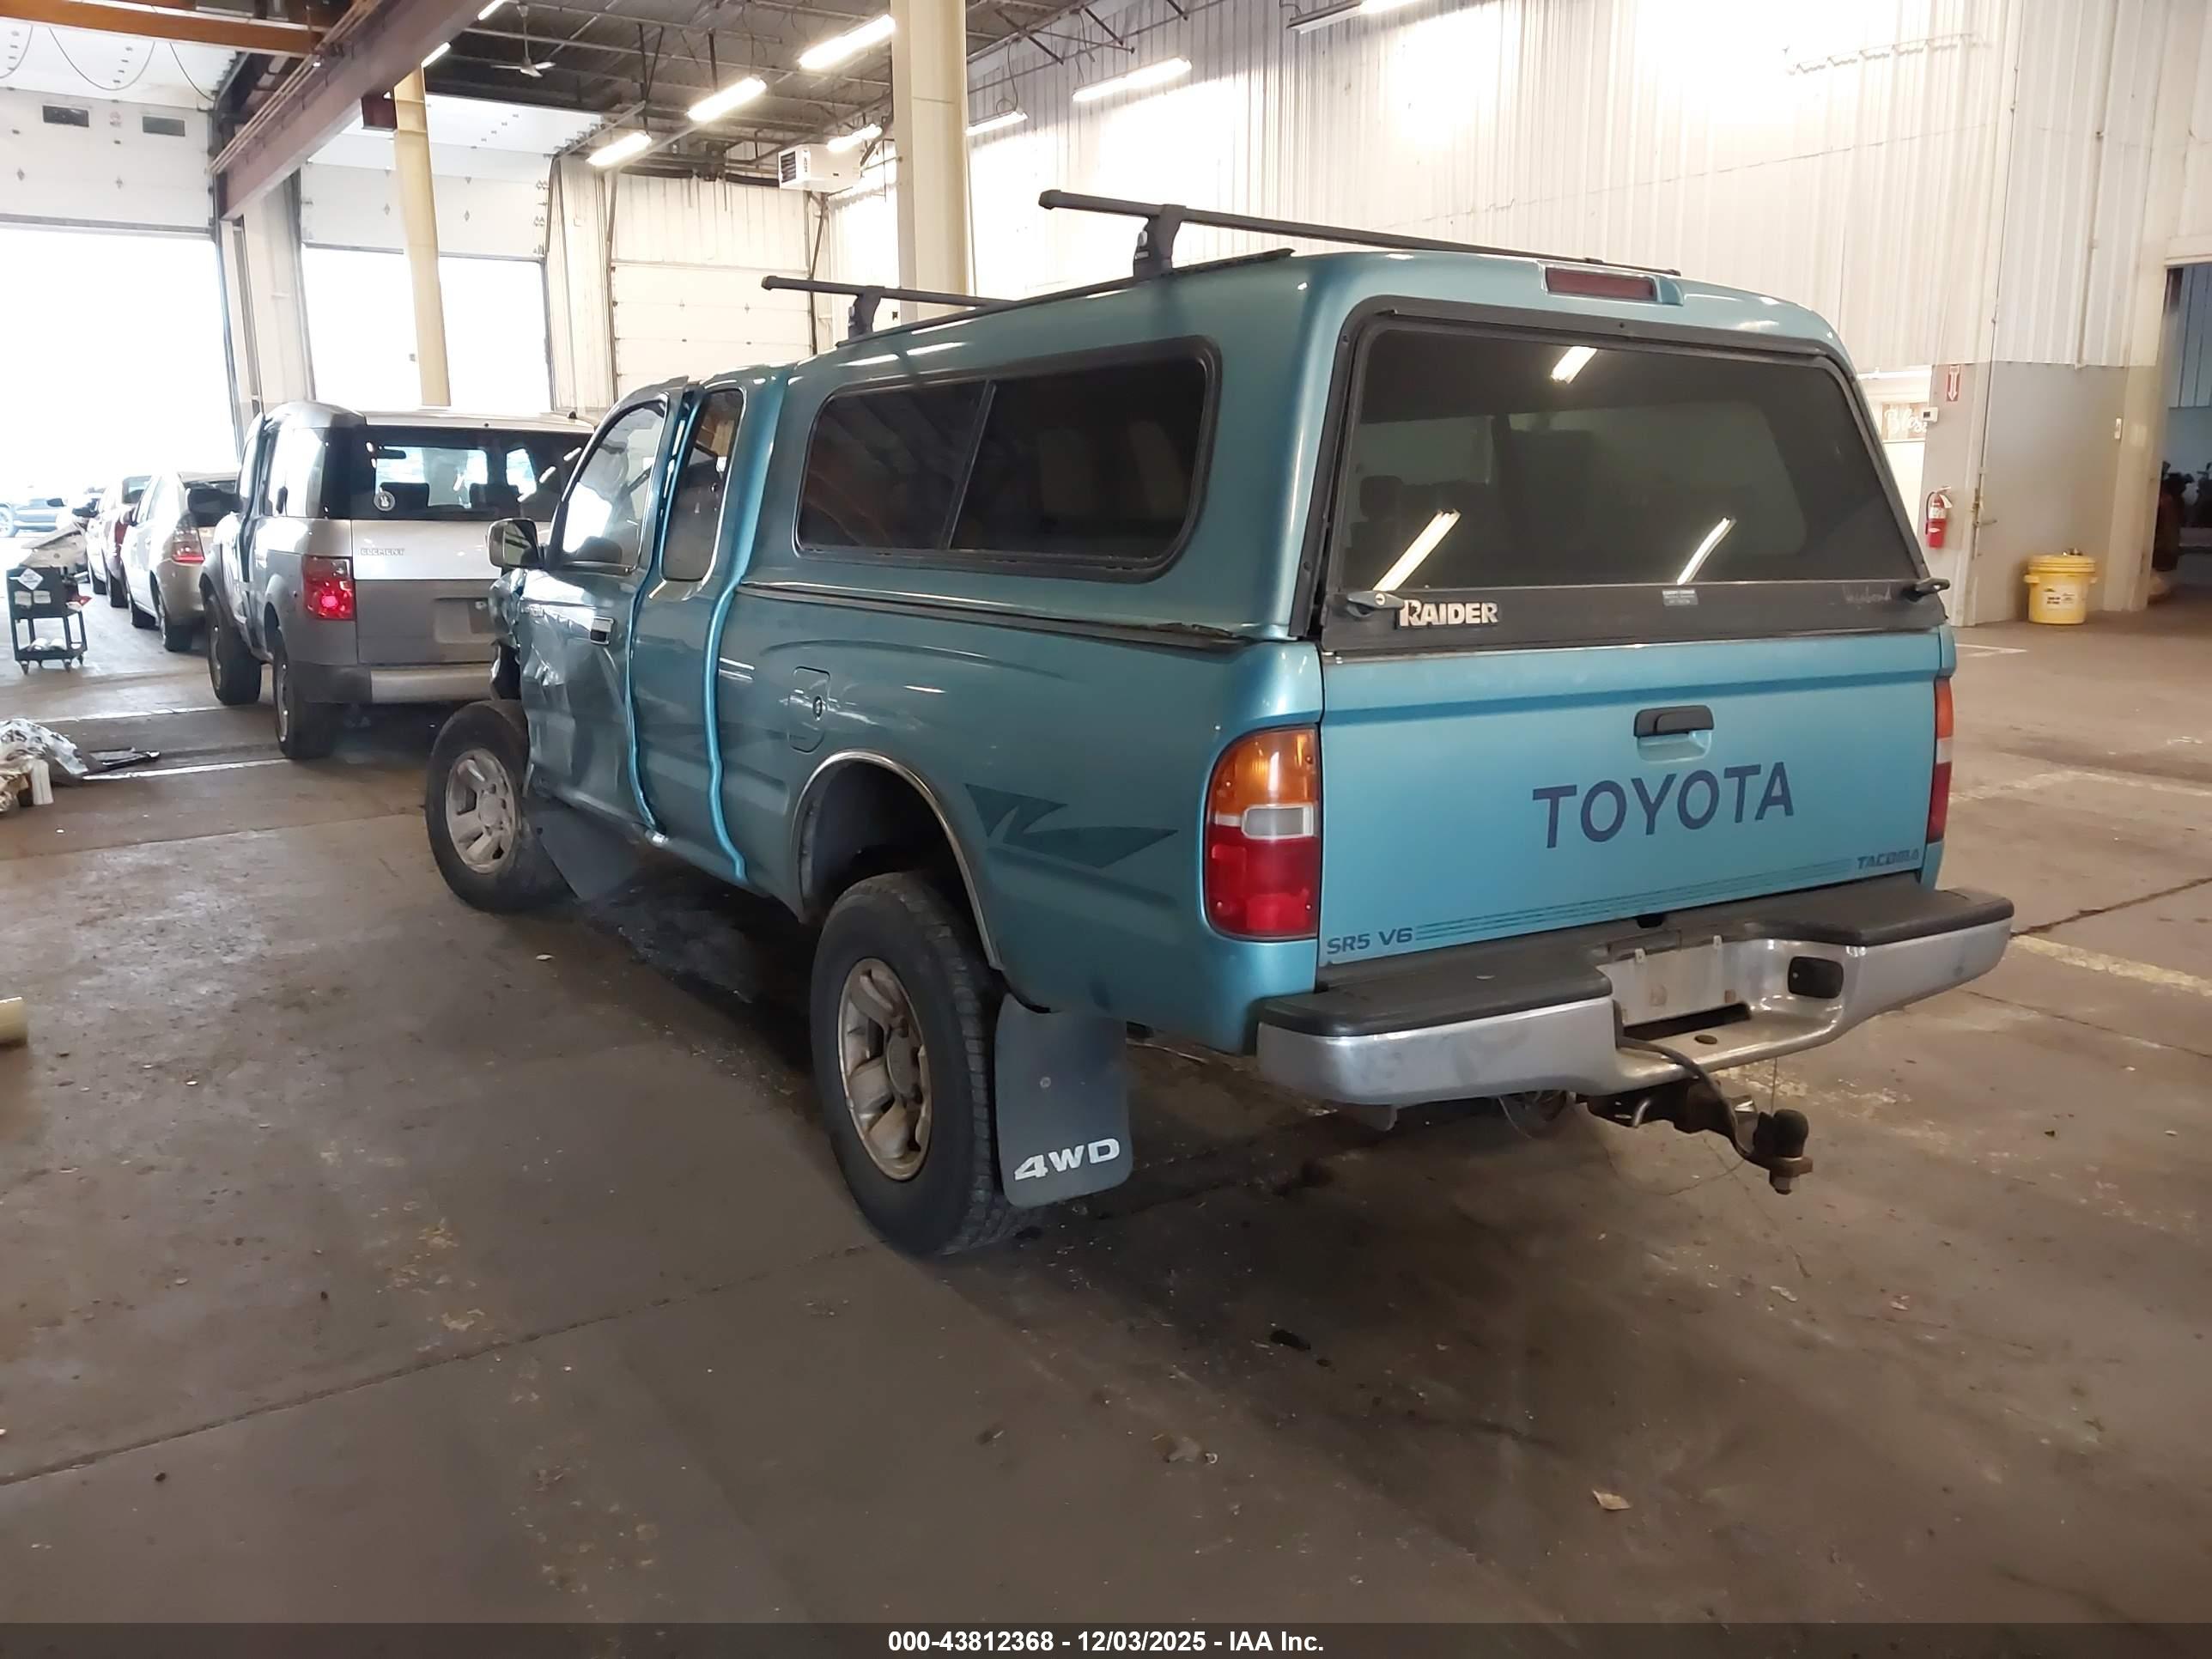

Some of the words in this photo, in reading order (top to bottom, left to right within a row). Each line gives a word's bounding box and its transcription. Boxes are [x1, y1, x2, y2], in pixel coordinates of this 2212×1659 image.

[1399, 599, 1498, 627] RAIDER
[1532, 762, 1794, 848] TOYOTA
[1856, 848, 1920, 870] TACOMA
[1327, 933, 1371, 955] SR5
[1378, 927, 1413, 946] V6
[1014, 1138, 1121, 1182] 4WD
